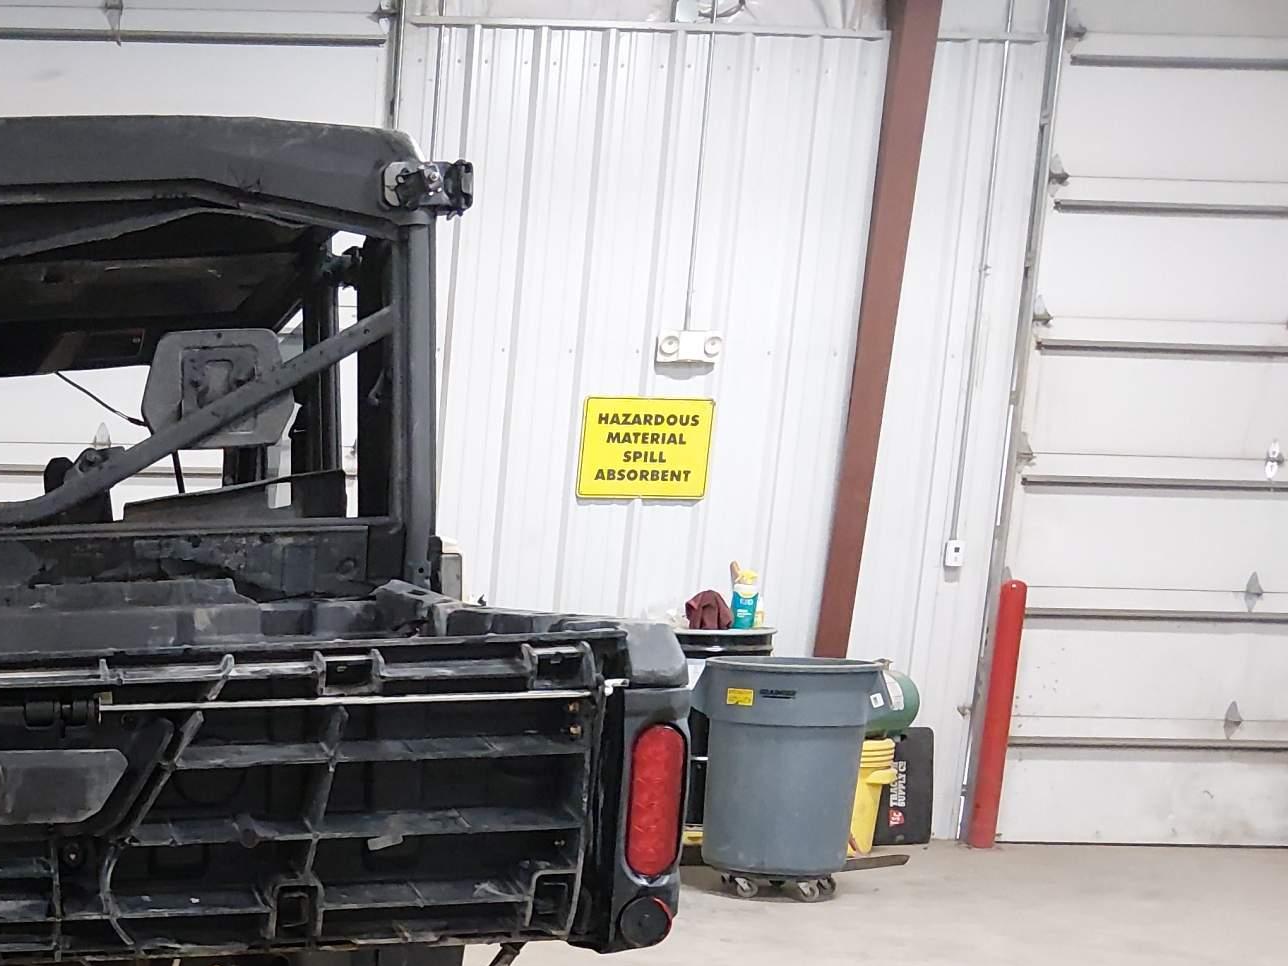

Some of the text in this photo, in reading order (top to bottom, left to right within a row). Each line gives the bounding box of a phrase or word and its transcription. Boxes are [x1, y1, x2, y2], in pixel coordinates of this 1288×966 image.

[597, 412, 700, 427] HAZARDOUS
[605, 431, 687, 445] MATERIAL
[622, 450, 667, 463] SPILL
[594, 468, 692, 482] ABSORBENT
[898, 773, 907, 807] SUPPLY
